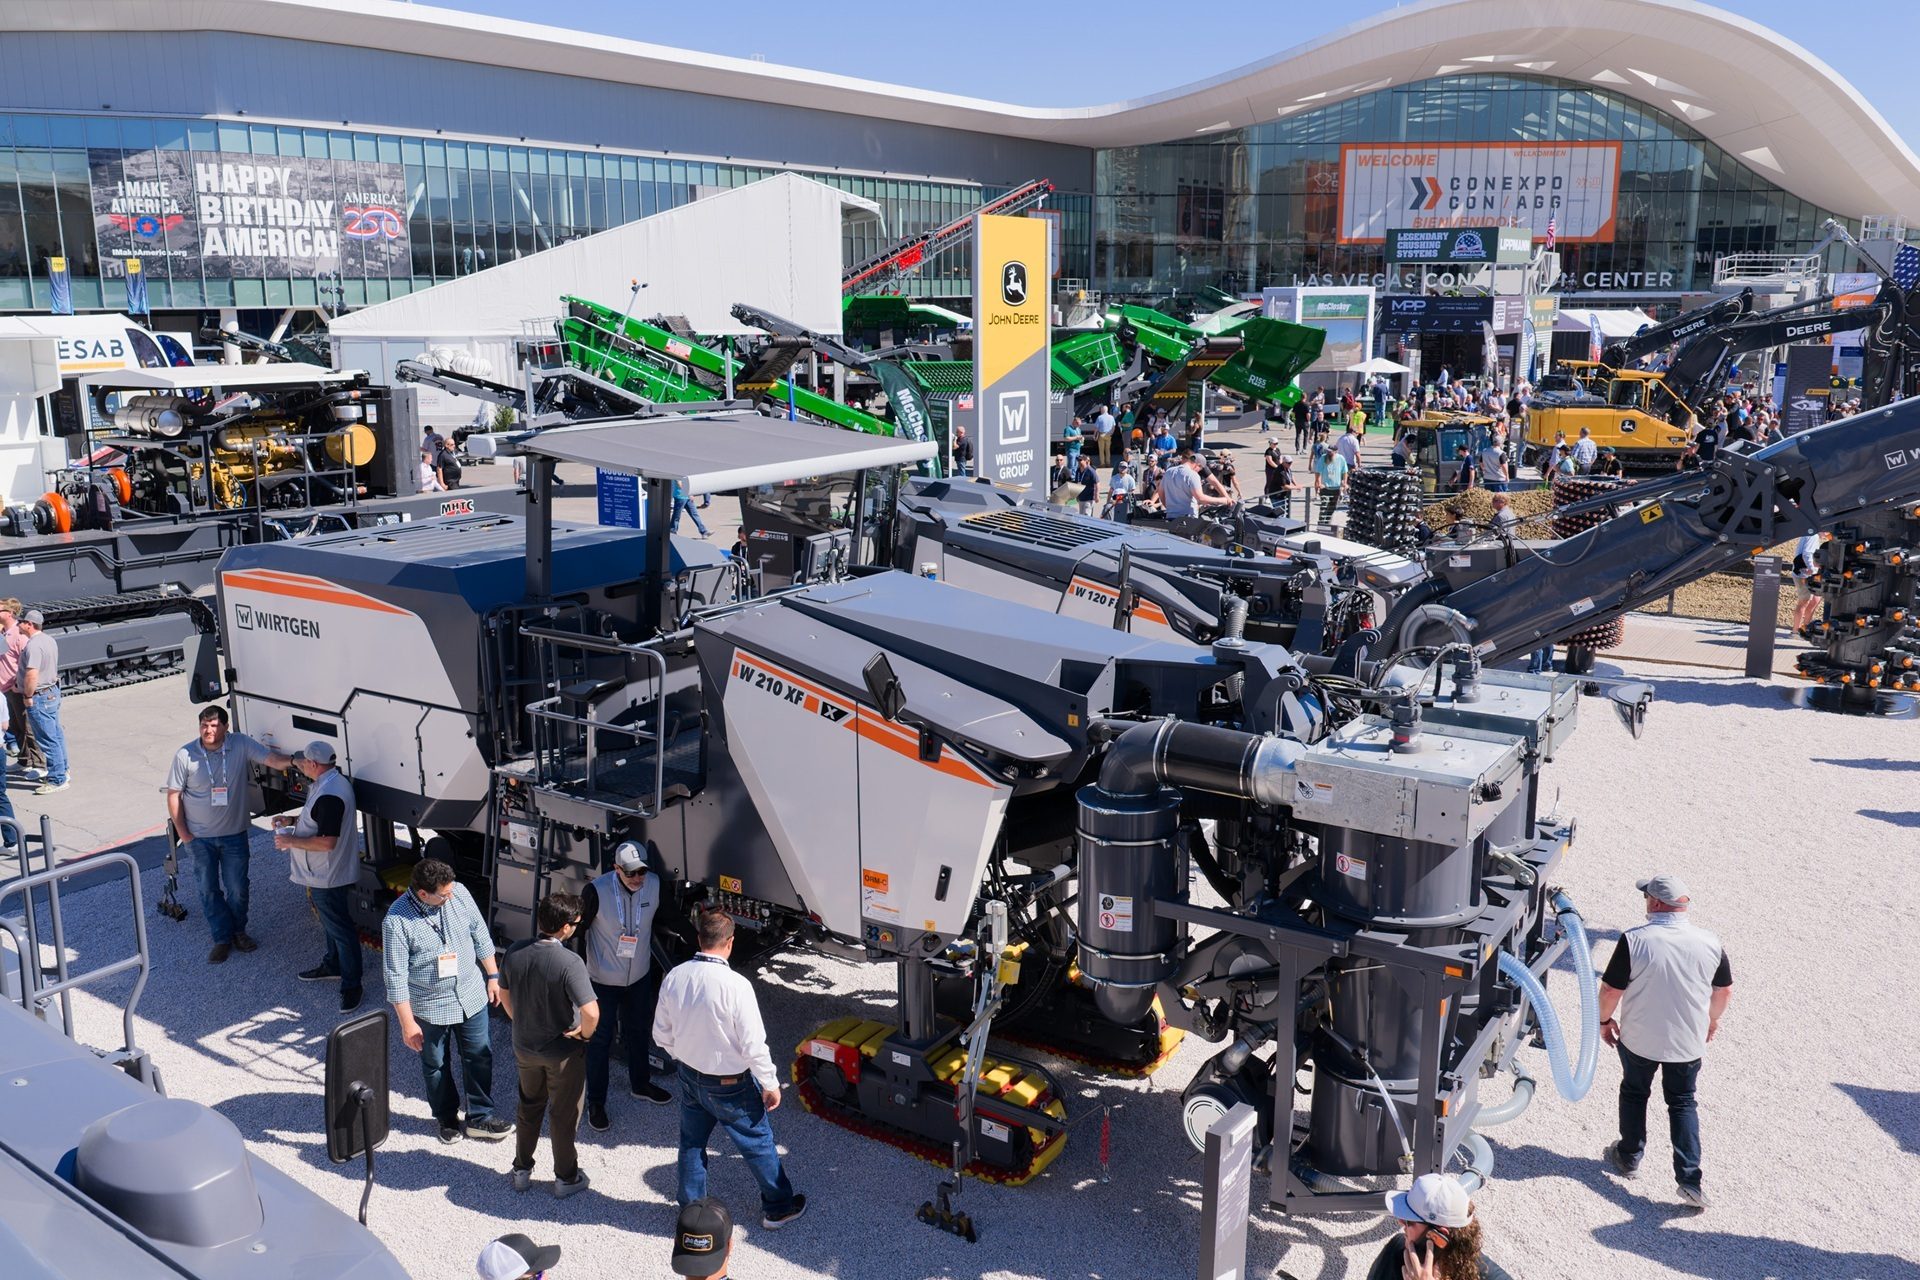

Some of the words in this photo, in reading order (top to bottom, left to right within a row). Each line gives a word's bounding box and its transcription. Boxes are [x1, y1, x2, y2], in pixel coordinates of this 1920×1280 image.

[1358, 154, 1437, 167] WELCOME
[1513, 149, 1567, 158] WILLKOMMEN
[196, 163, 291, 195] HAPPY
[1450, 176, 1563, 190] CONEXPO
[118, 181, 124, 196] I
[126, 181, 170, 197] MAKE
[344, 192, 398, 205] AMERICA
[200, 195, 334, 227] BIRTHDAY
[344, 206, 404, 240] 250
[1411, 217, 1518, 228] BIENVENIDOS
[203, 227, 338, 257] AMERICA!
[1397, 232, 1449, 241] LEGENDARY
[1397, 241, 1440, 249] CRUSHING
[1500, 239, 1530, 251] LIPPMANN
[1396, 249, 1438, 258] SYSTEMS
[1292, 273, 1333, 287] LAS
[1341, 273, 1416, 288] VEGAS
[1583, 272, 1672, 287] CENTER
[1317, 302, 1352, 312] McCloskey
[1392, 300, 1426, 311] MPP
[989, 313, 1012, 325] JOHN
[1013, 313, 1039, 325] DEERE
[1672, 318, 1706, 338] DEERE
[1786, 321, 1831, 338] DEERE
[58, 339, 124, 359] ESAB
[995, 449, 1033, 466] WIRTGEN
[1000, 464, 1029, 480] GROUP
[441, 500, 474, 515] MHTC
[1075, 586, 1086, 598] W
[1088, 591, 1107, 605] 120
[254, 611, 320, 639] WIRTGEN
[740, 664, 755, 682] W
[755, 672, 783, 696] 210
[784, 685, 804, 705] XF
[823, 705, 838, 719] X
[864, 875, 887, 886] ORM-C
